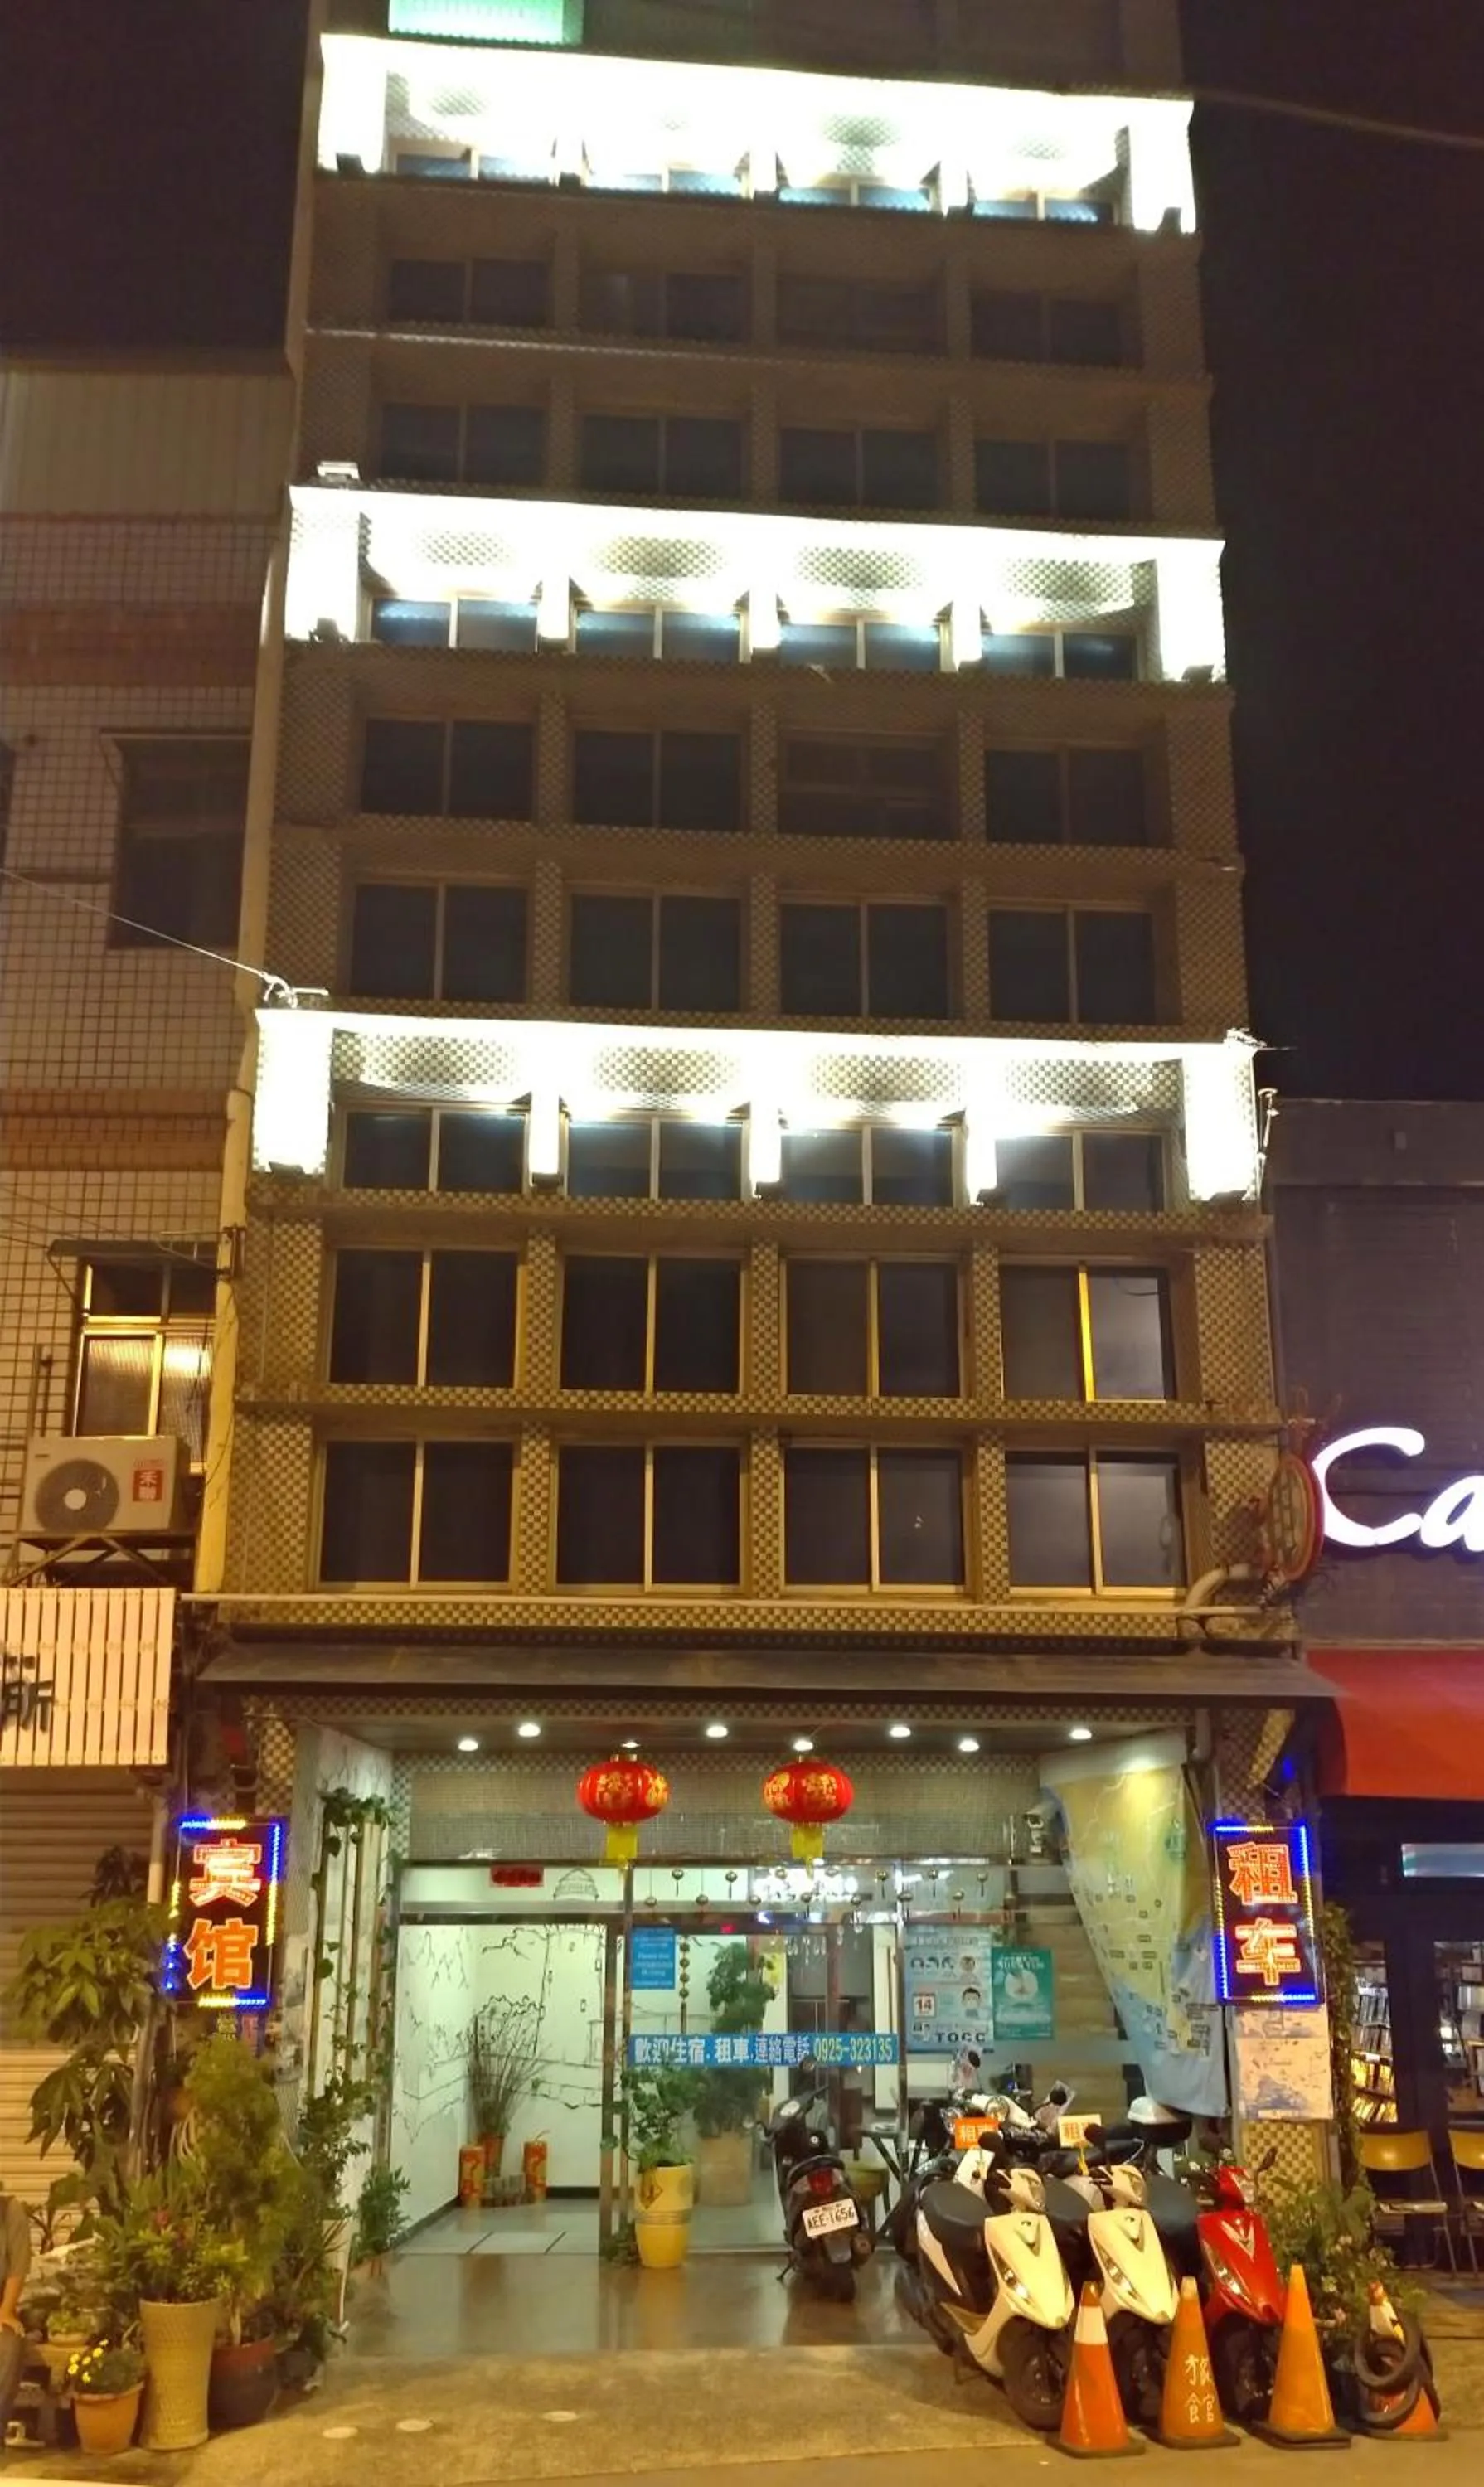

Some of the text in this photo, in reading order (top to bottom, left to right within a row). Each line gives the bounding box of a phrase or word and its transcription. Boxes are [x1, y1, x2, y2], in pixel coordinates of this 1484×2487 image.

[183, 1838, 264, 1990] 宾馆
[1227, 1841, 1301, 1986] 租车
[916, 1999, 932, 2011] 14
[812, 2037, 894, 2063] 0925-323135
